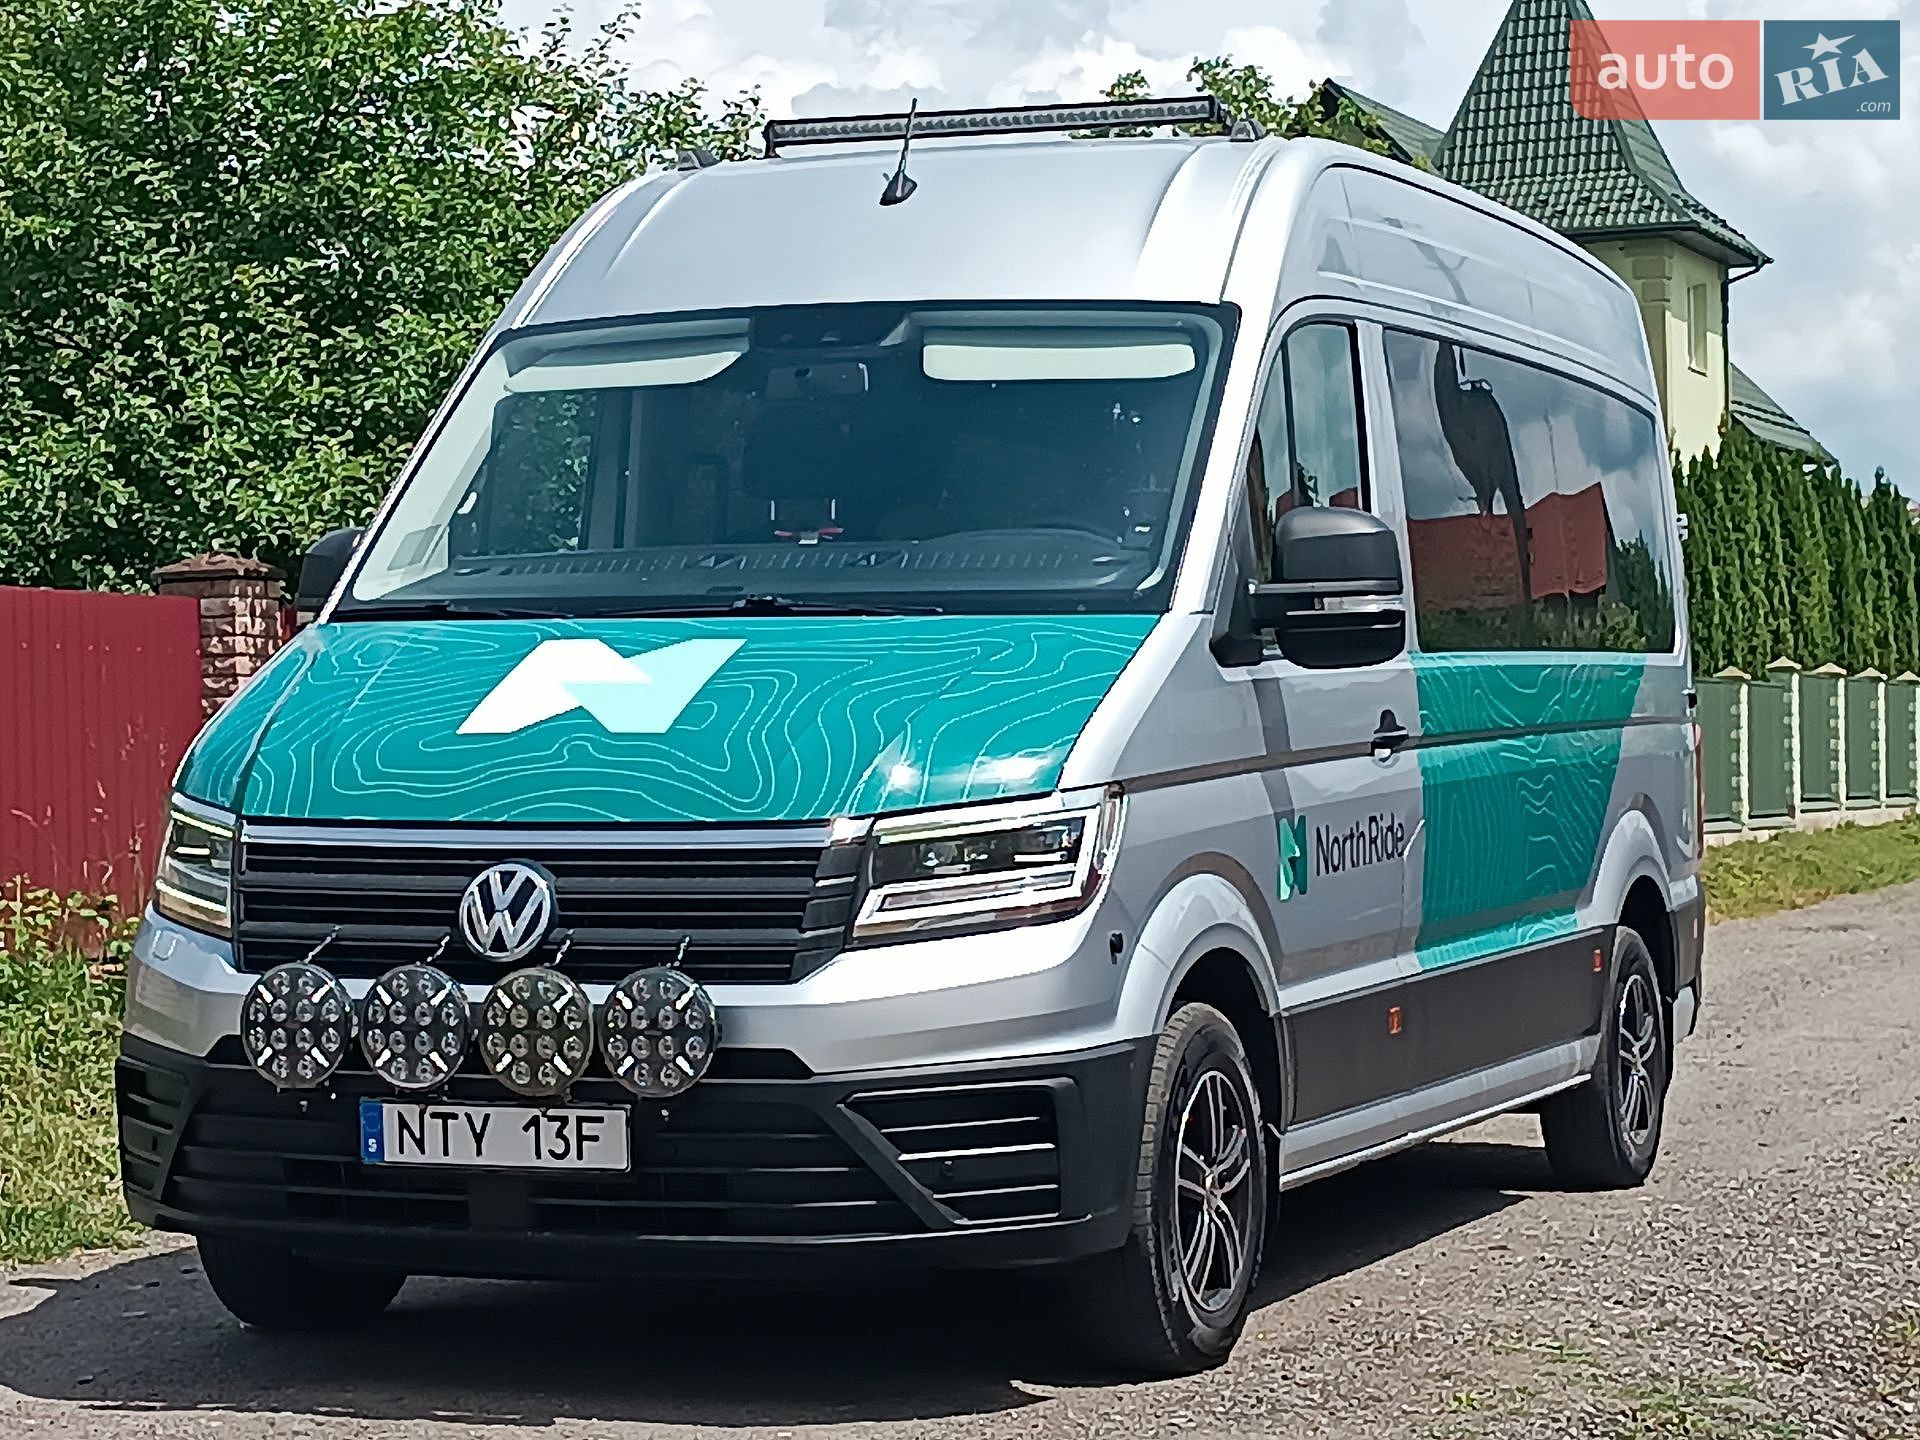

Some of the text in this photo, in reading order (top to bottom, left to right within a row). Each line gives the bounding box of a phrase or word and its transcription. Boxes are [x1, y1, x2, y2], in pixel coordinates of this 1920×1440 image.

[1316, 812, 1405, 877] NorthRide
[397, 1110, 605, 1160] NTY 13F
